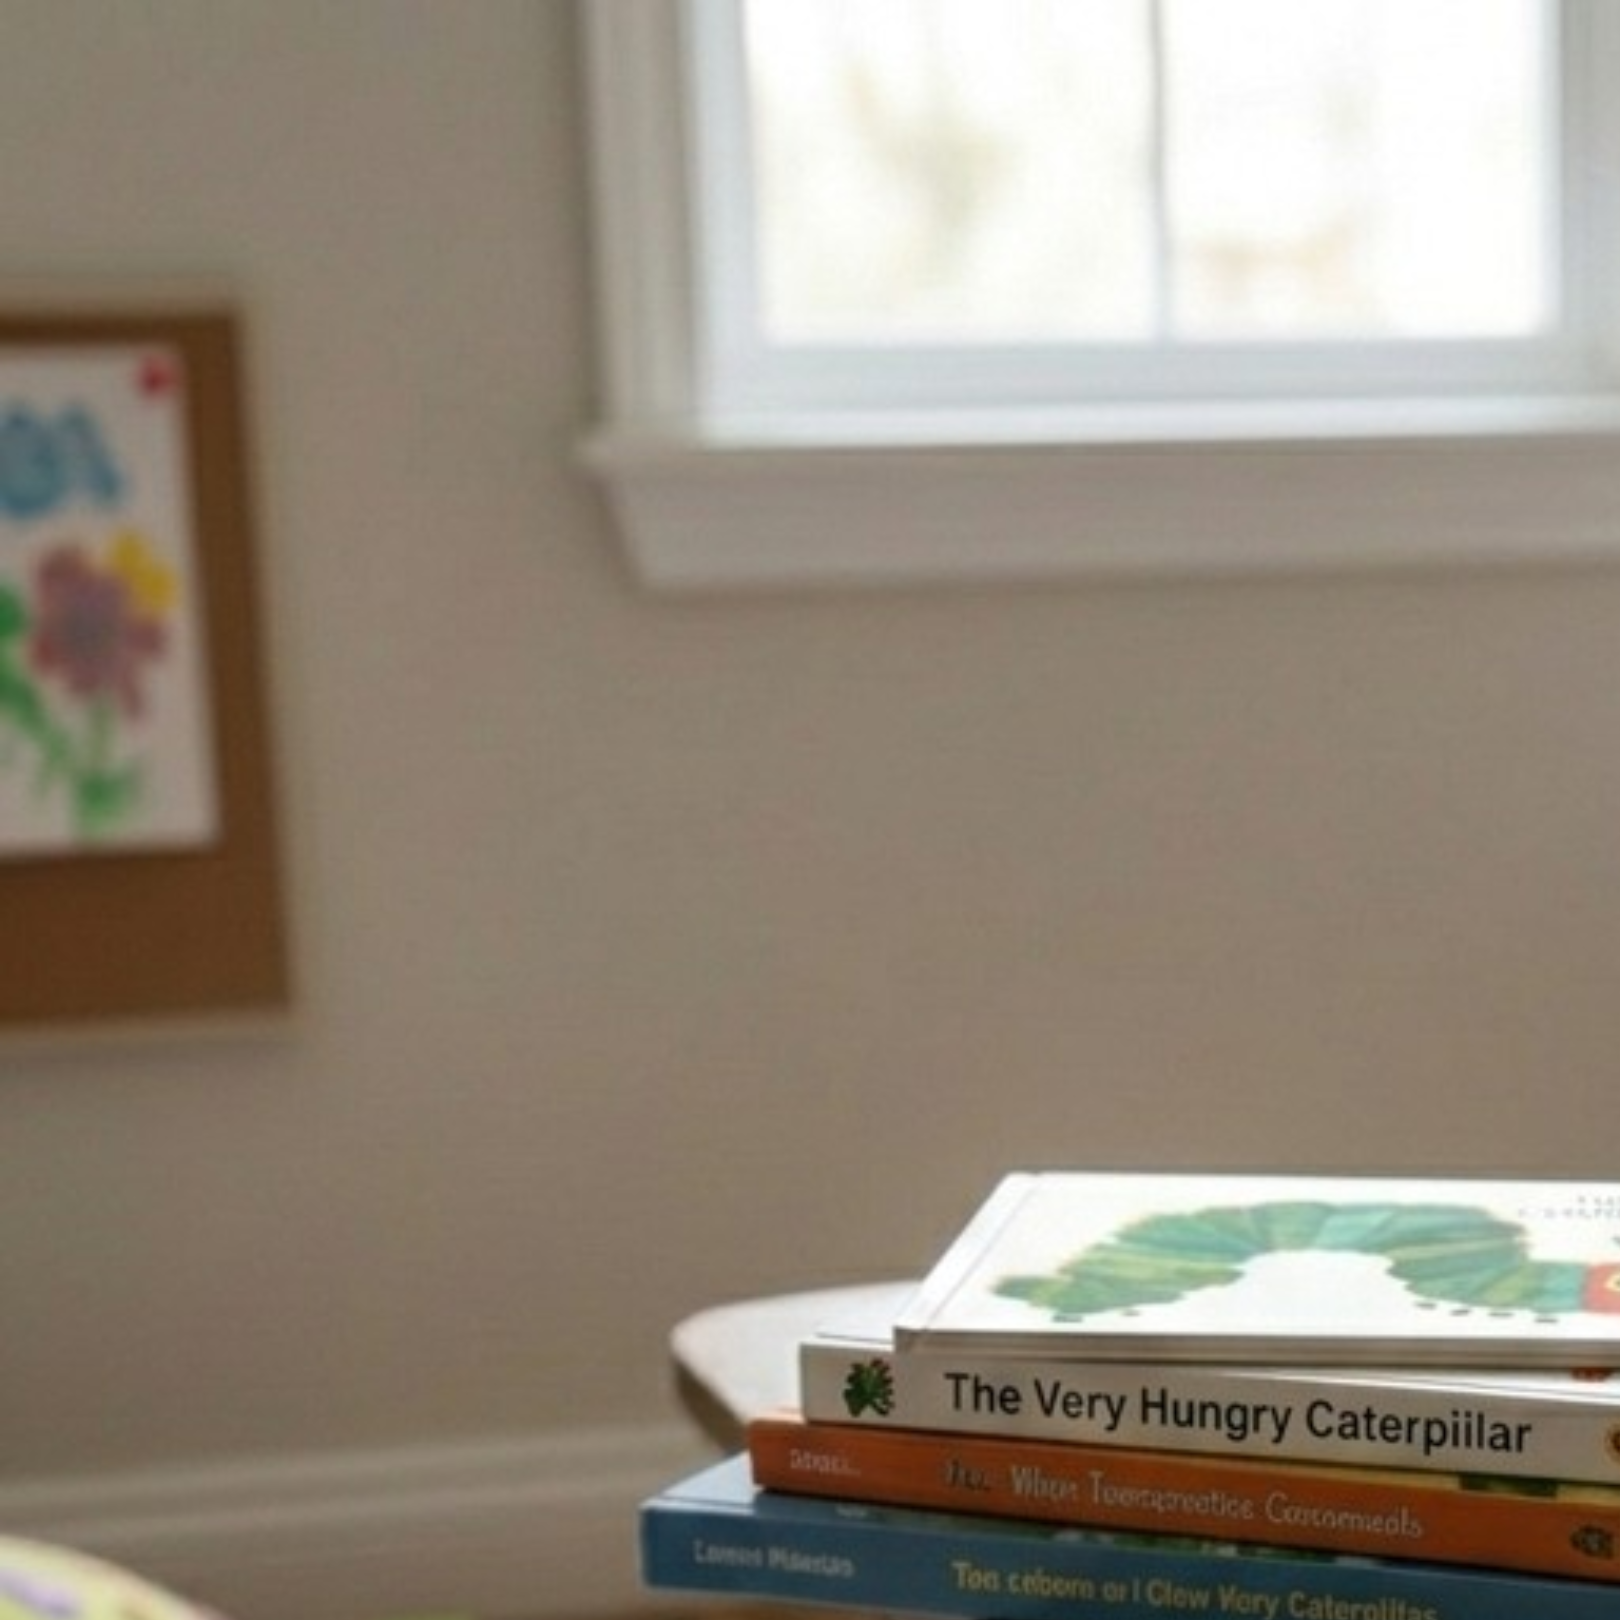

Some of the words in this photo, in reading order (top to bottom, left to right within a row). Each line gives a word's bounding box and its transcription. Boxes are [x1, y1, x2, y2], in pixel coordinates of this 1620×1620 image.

[945, 1372, 1021, 1416] The
[1033, 1378, 1127, 1432] Very
[1141, 1387, 1293, 1444] Hungry
